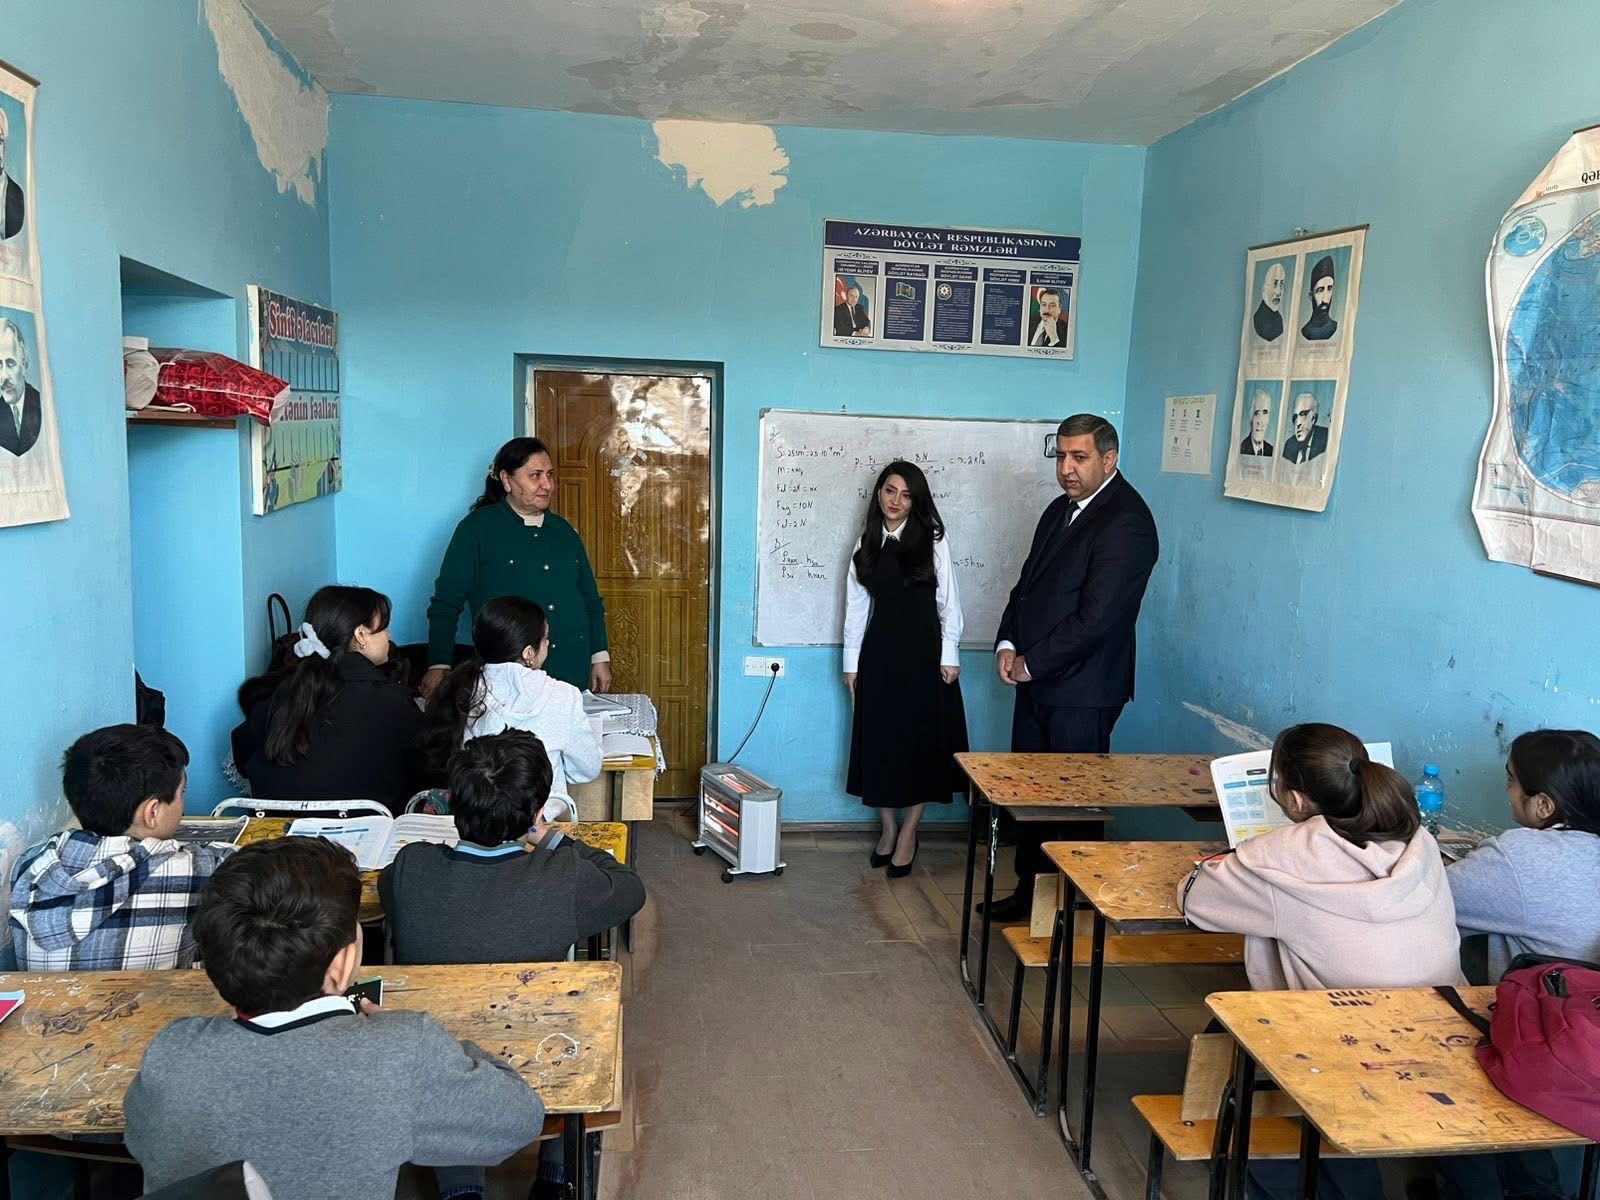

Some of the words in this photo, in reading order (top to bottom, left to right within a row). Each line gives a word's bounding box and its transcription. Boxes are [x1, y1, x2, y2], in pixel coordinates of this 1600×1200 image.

[854, 228, 941, 240] AZƏRBAYCAN
[947, 234, 1057, 247] RESPUBLİKASININ
[893, 239, 945, 251] DÖVLƏT
[951, 244, 1018, 255] RƏMZLƏRİ
